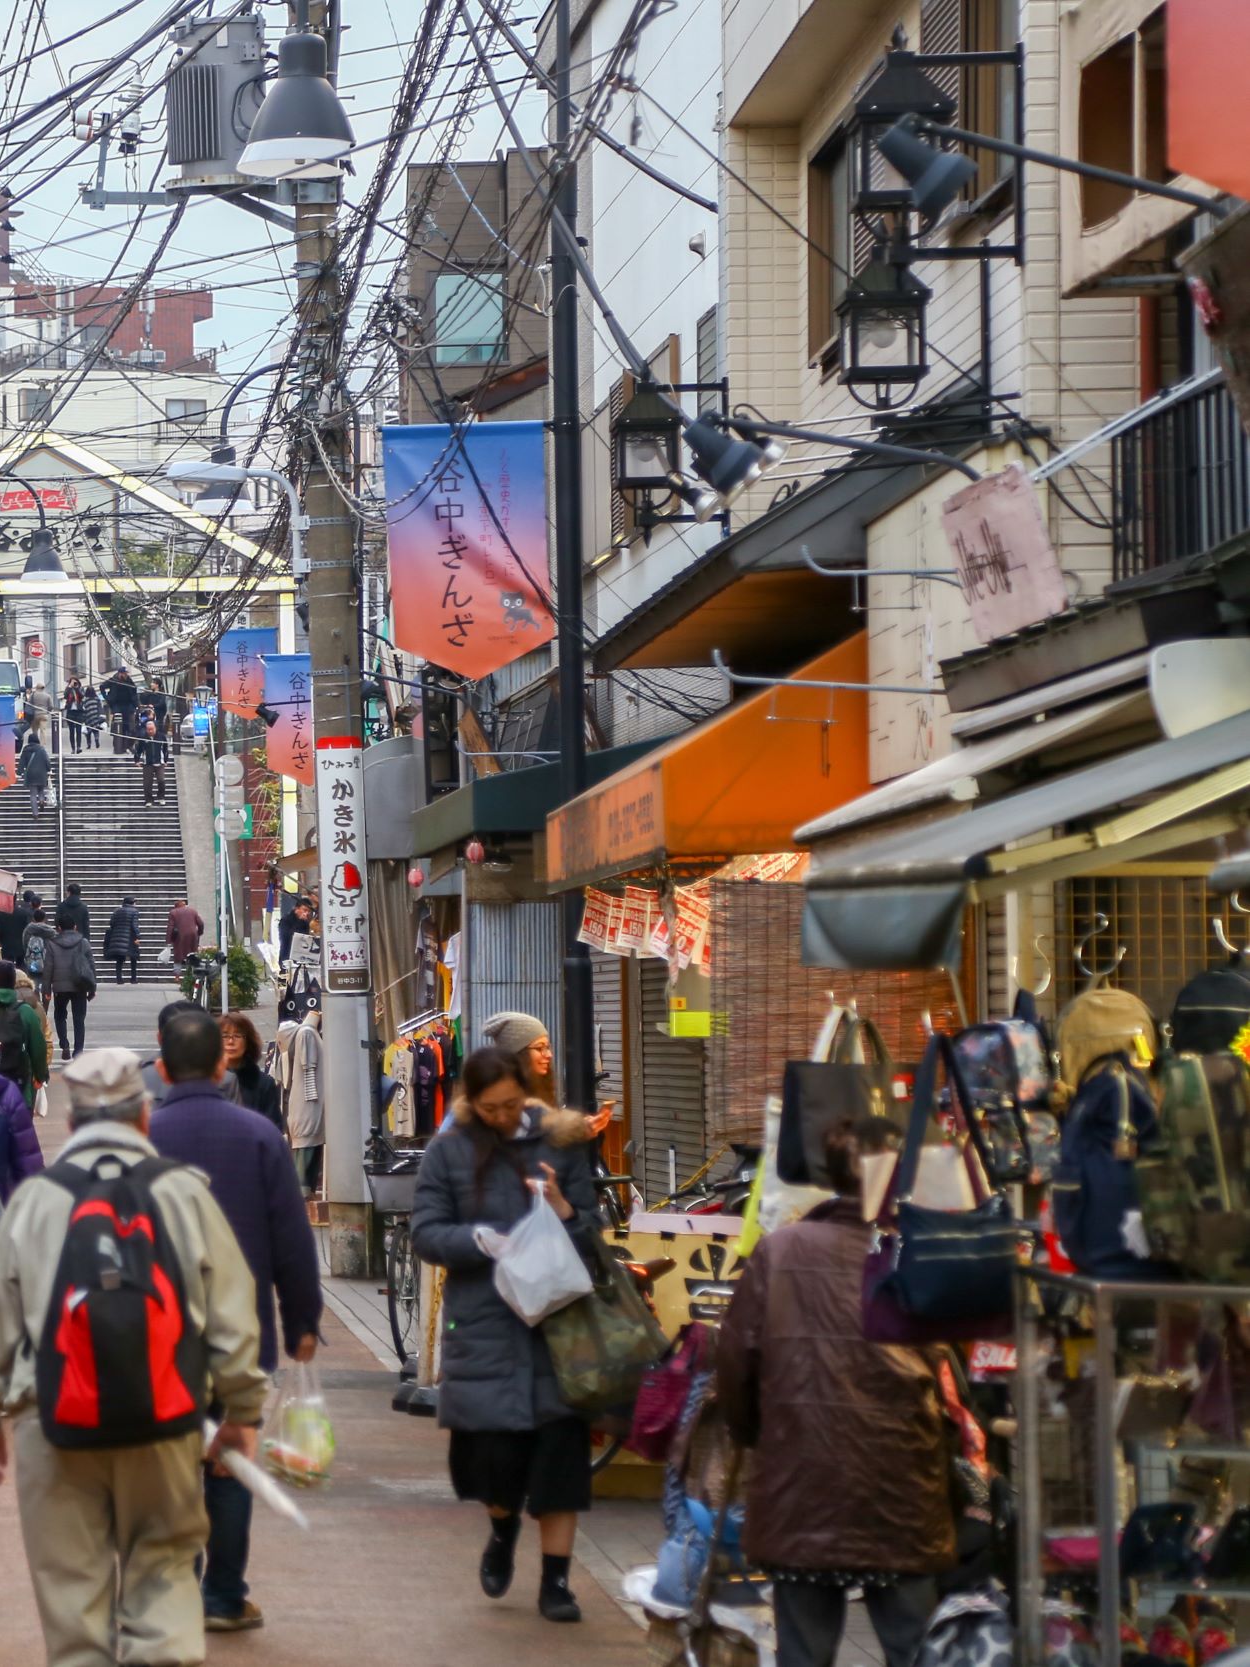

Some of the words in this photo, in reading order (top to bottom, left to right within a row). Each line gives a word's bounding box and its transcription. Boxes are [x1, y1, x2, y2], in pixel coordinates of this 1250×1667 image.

[433, 458, 474, 647] 谷中ぎんざ
[289, 671, 310, 770] 谷中ぎんざ
[332, 778, 358, 855] かき氷
